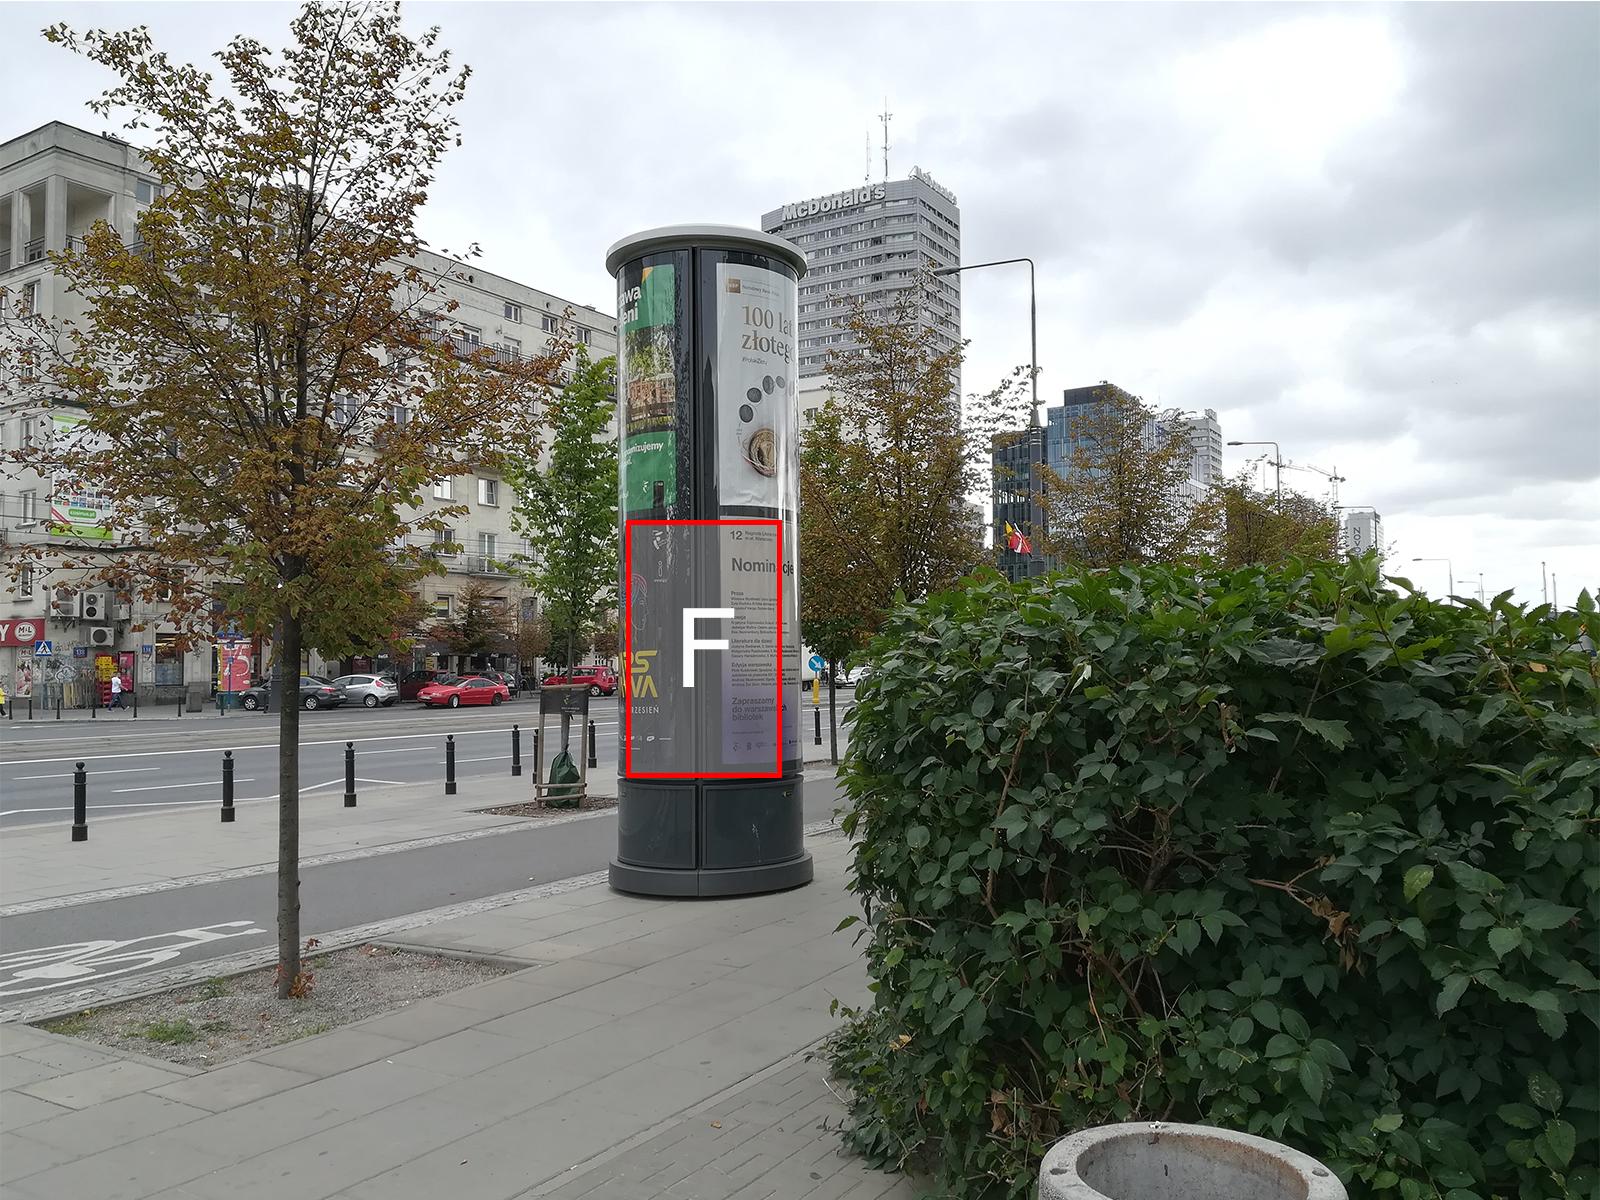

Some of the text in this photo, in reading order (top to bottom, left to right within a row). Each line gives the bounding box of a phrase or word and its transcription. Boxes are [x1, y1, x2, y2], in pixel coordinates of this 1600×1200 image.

[782, 184, 886, 221] McDonald's
[741, 304, 793, 338] 100 lat
[730, 530, 743, 541] 12
[731, 558, 794, 576] Nomincje
